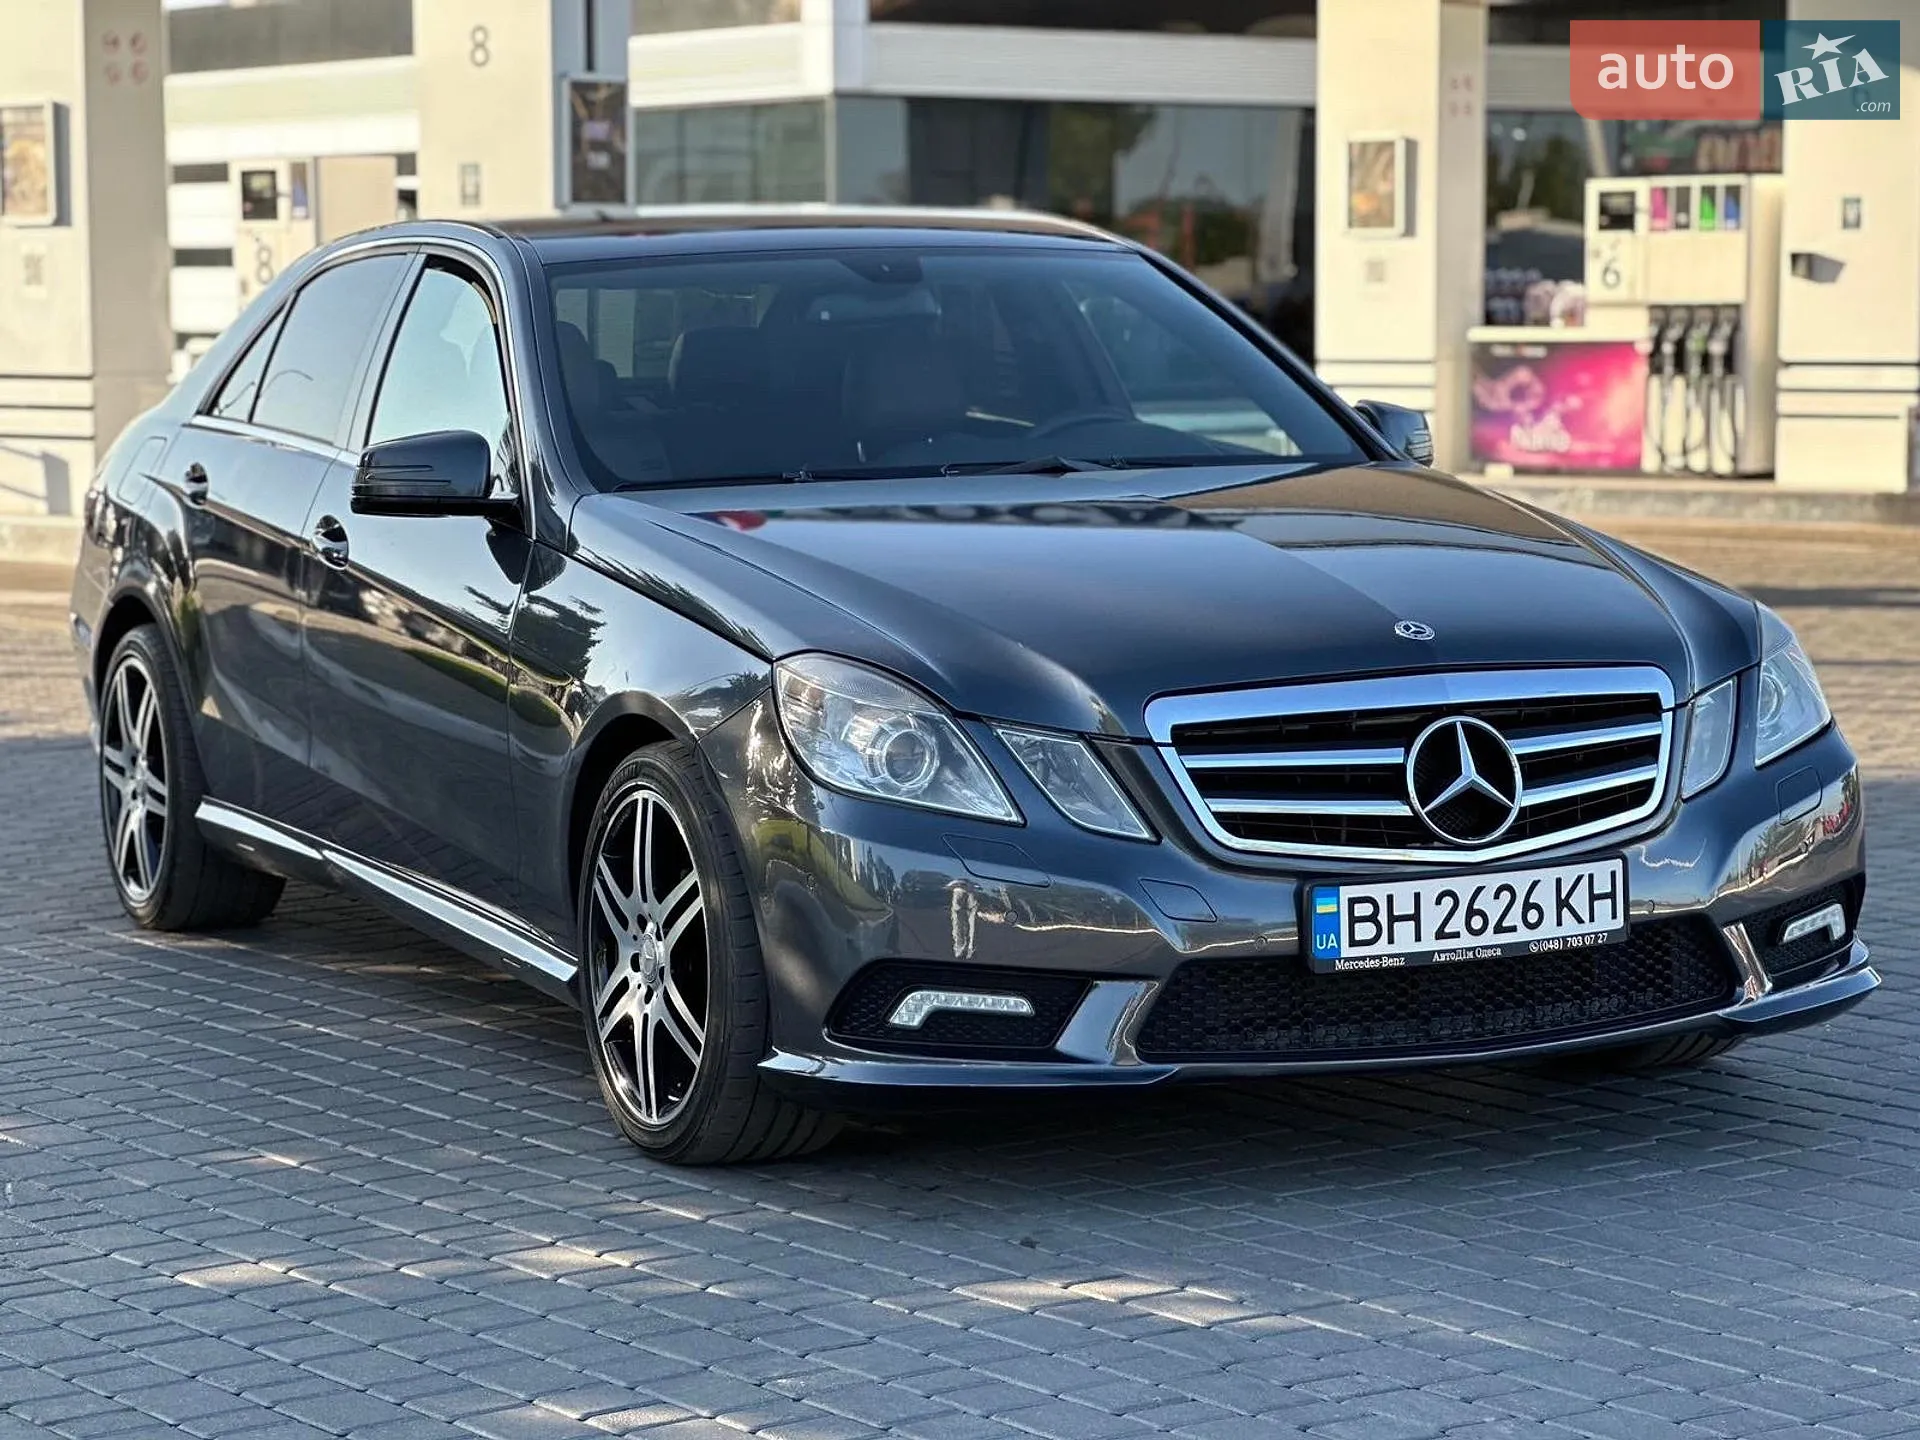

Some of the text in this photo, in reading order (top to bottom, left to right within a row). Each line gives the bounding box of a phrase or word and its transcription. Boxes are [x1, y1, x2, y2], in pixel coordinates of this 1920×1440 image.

[469, 25, 490, 66] 8
[256, 245, 274, 285] 8
[1602, 256, 1621, 288] 6
[1347, 870, 1619, 948] BH 2626 KH
[1316, 933, 1339, 950] UA
[1475, 946, 1502, 959] Одеса
[1539, 932, 1609, 952] (048) 703 07 27
[1334, 955, 1406, 971] Mercedes-Benz
